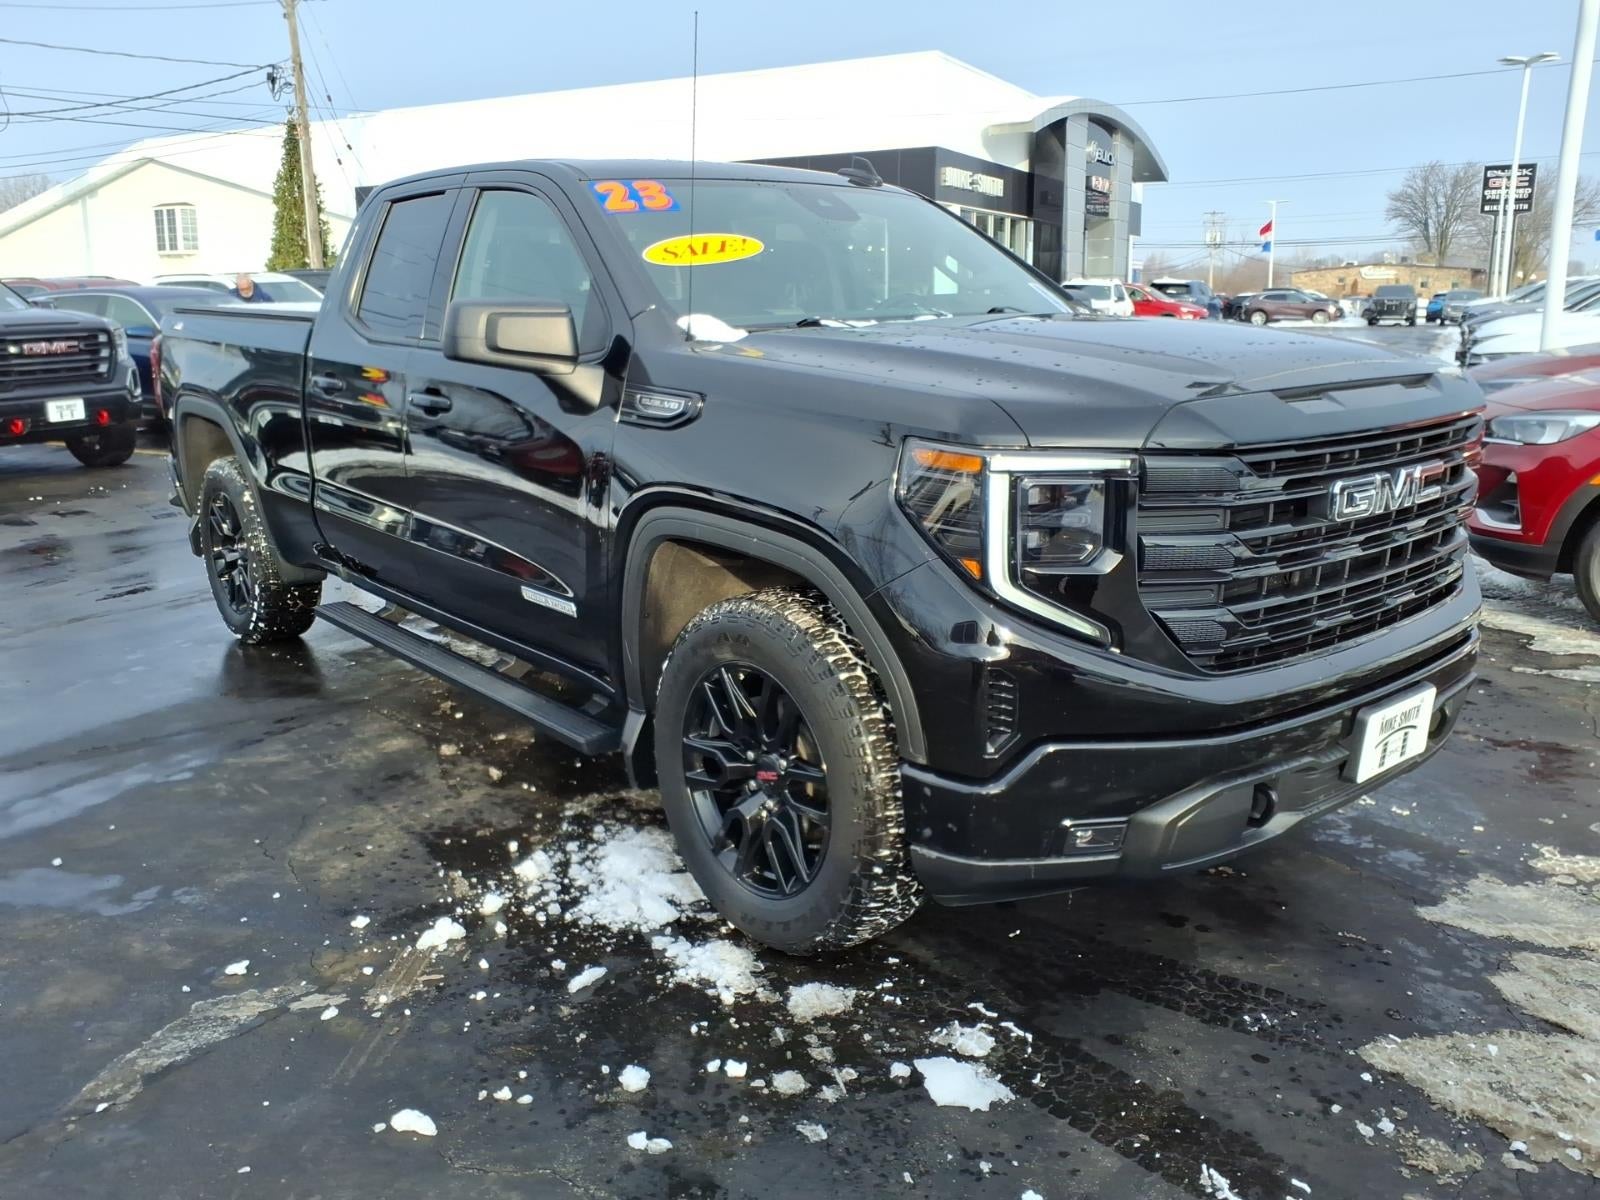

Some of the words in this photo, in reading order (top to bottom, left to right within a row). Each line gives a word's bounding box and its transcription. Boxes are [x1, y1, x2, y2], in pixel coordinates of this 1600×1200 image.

[1489, 177, 1529, 188] GC
[594, 180, 673, 213] 23
[661, 238, 748, 261] SALE!
[22, 341, 79, 355] GMC
[1329, 461, 1444, 521] GMC
[1399, 704, 1422, 728] SMITH
